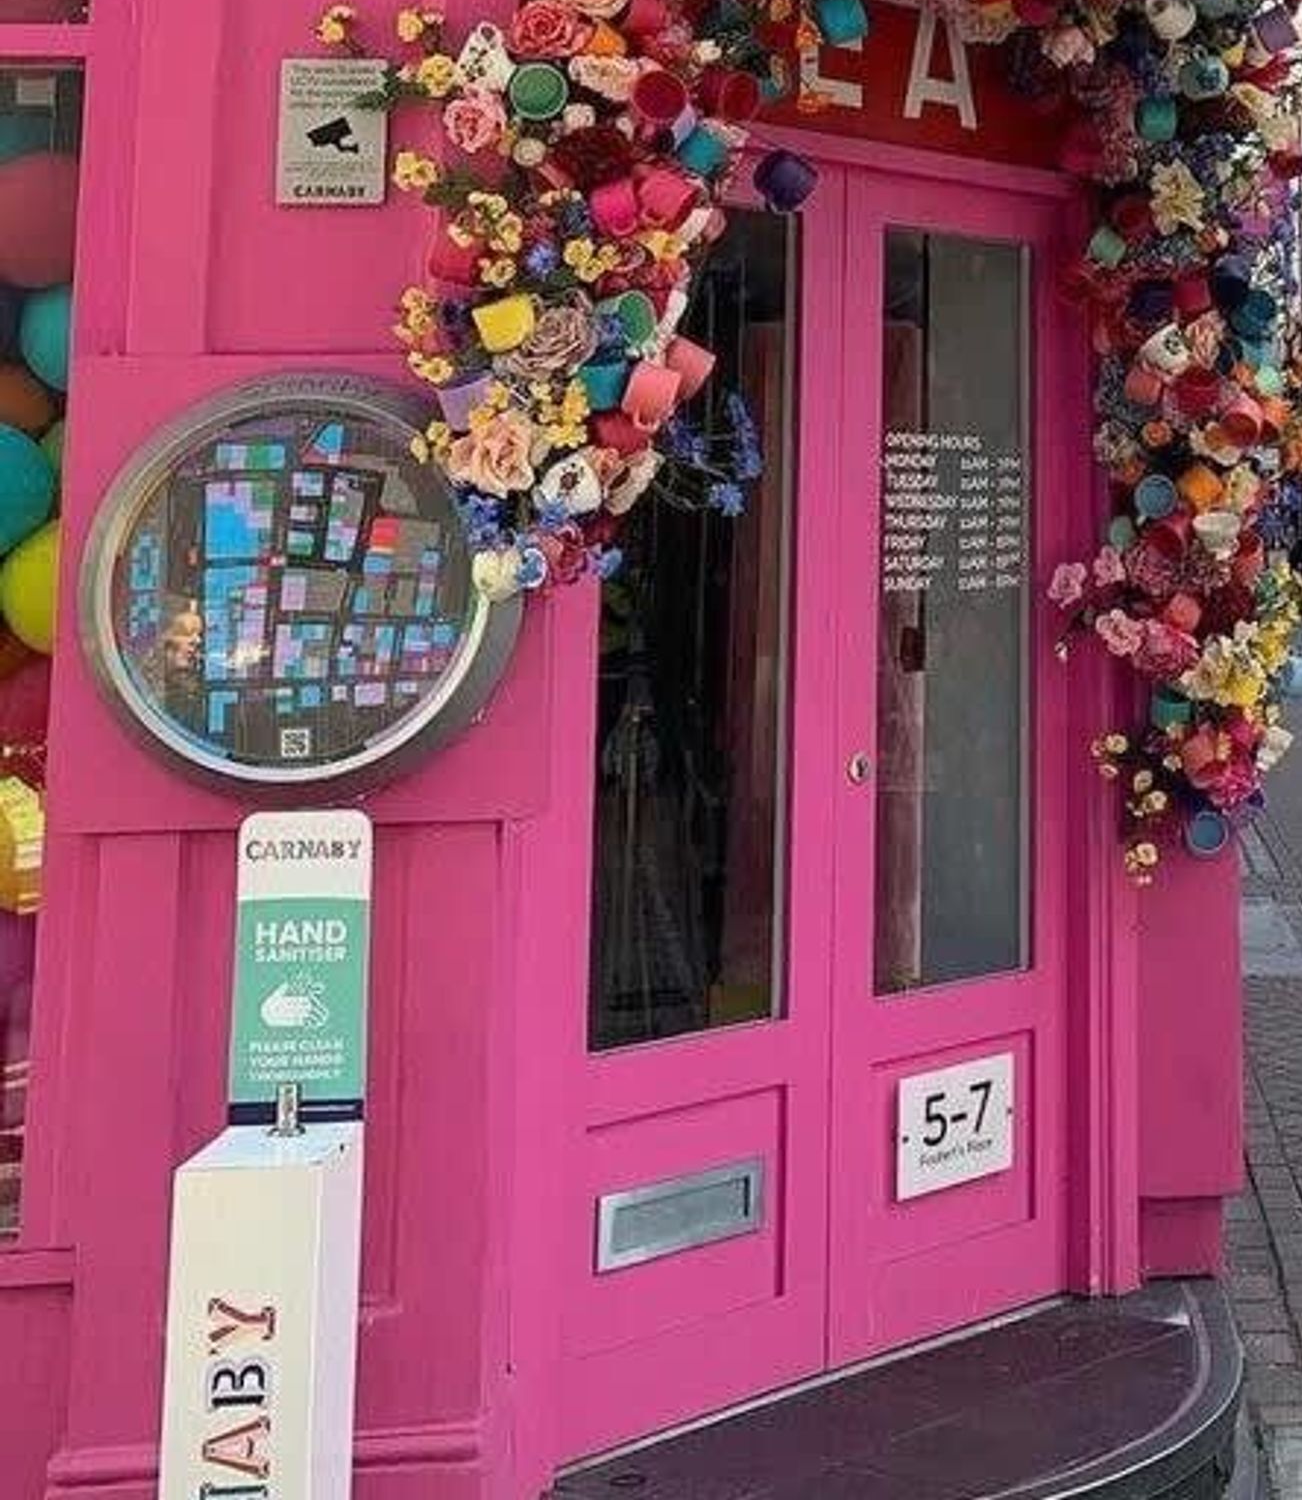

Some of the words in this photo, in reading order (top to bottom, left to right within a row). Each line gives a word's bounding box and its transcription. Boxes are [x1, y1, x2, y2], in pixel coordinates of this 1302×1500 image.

[292, 184, 366, 199] CARNABY
[884, 432, 939, 448] OPENING
[940, 436, 983, 451] HOURS
[884, 453, 938, 469] MONDAY
[886, 474, 939, 488] TUESDAY
[884, 494, 958, 509] WEDNESDAY
[884, 515, 947, 529] THURSDAY
[884, 536, 926, 550] FRIDAY
[884, 556, 945, 570] SATURDAY
[884, 576, 932, 591] SUNDAY
[246, 838, 363, 863] CARNABY
[254, 919, 347, 945] HAND
[254, 946, 348, 963] SANITISER
[298, 1037, 344, 1051] CLEAN
[248, 1055, 289, 1067] YOUR
[291, 1053, 344, 1066] HANDS
[922, 1079, 993, 1147] 5-7
